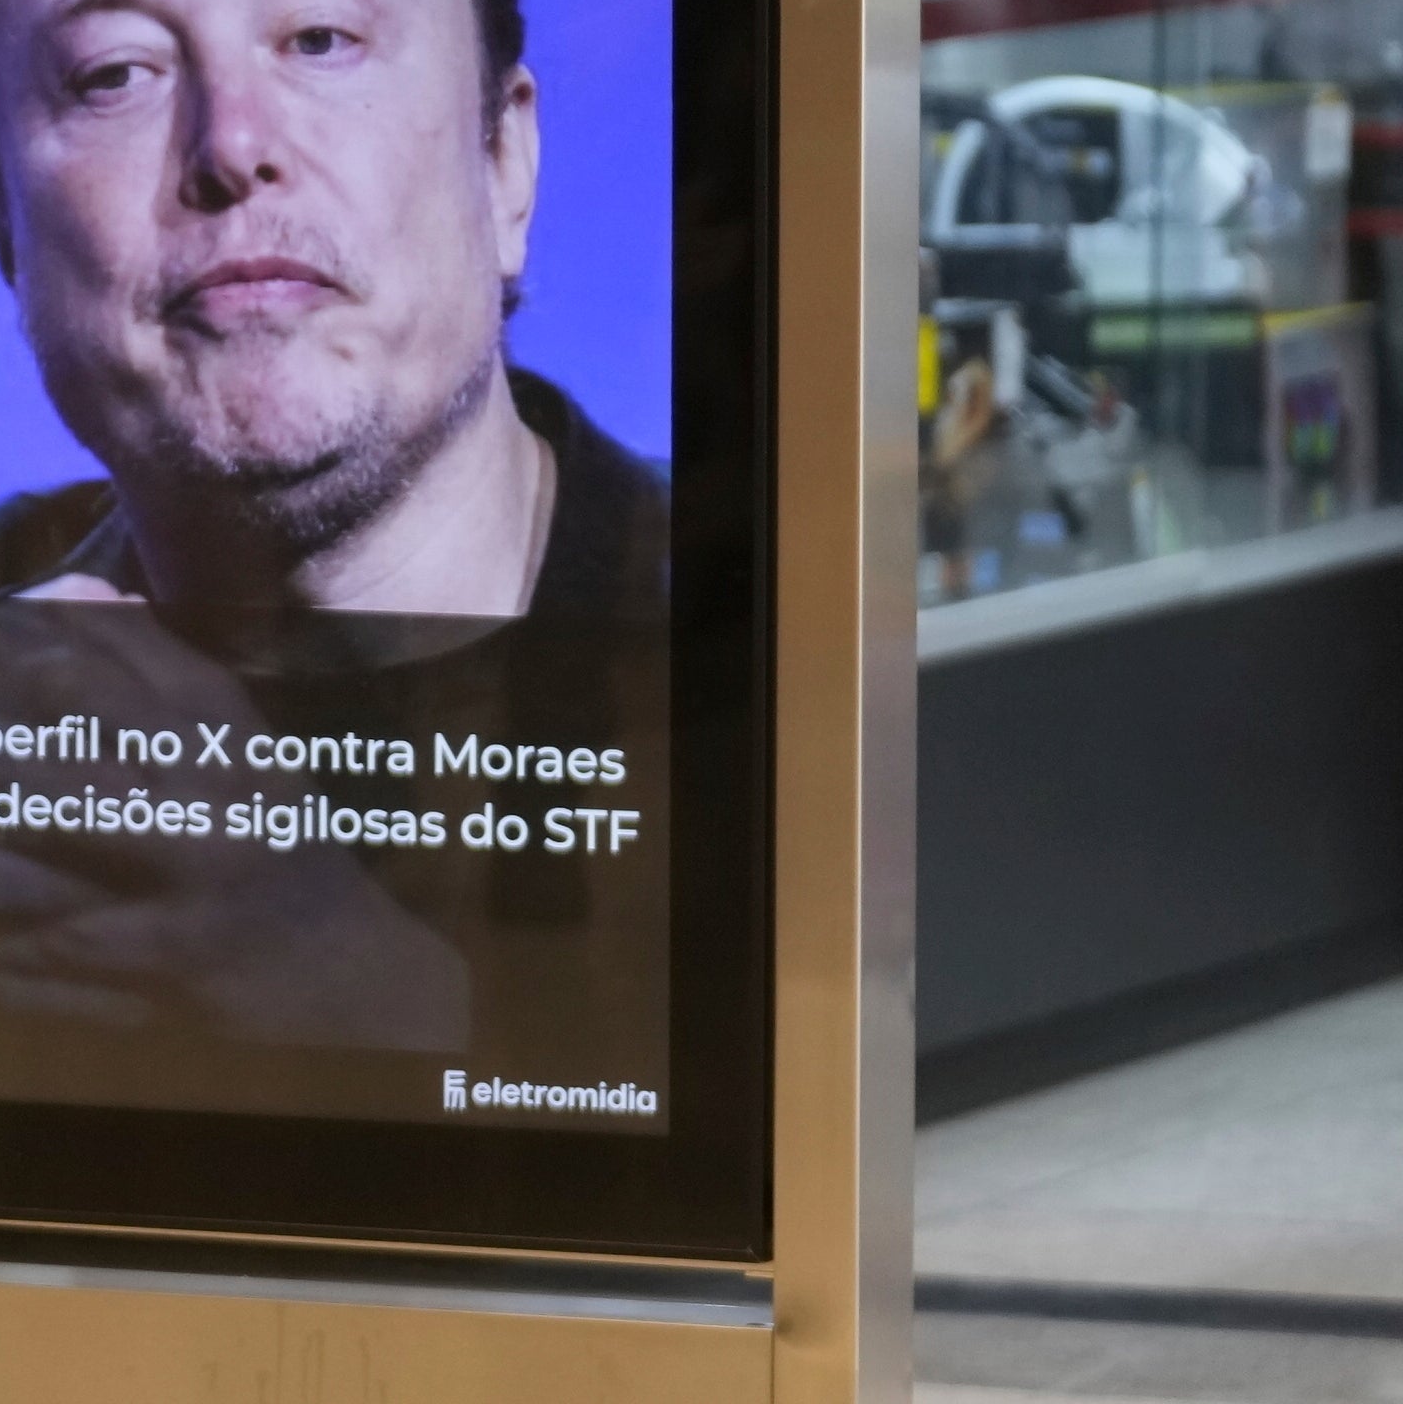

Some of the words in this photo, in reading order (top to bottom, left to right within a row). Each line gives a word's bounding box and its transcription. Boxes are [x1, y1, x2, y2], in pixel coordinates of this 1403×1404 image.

[116, 727, 184, 766] no
[195, 721, 233, 768] X
[244, 730, 416, 776] contra
[433, 732, 627, 785] Moraes
[224, 791, 448, 851] sigilosas
[459, 801, 530, 851] do
[543, 807, 641, 855] STF
[471, 1075, 658, 1116] eletromidia
